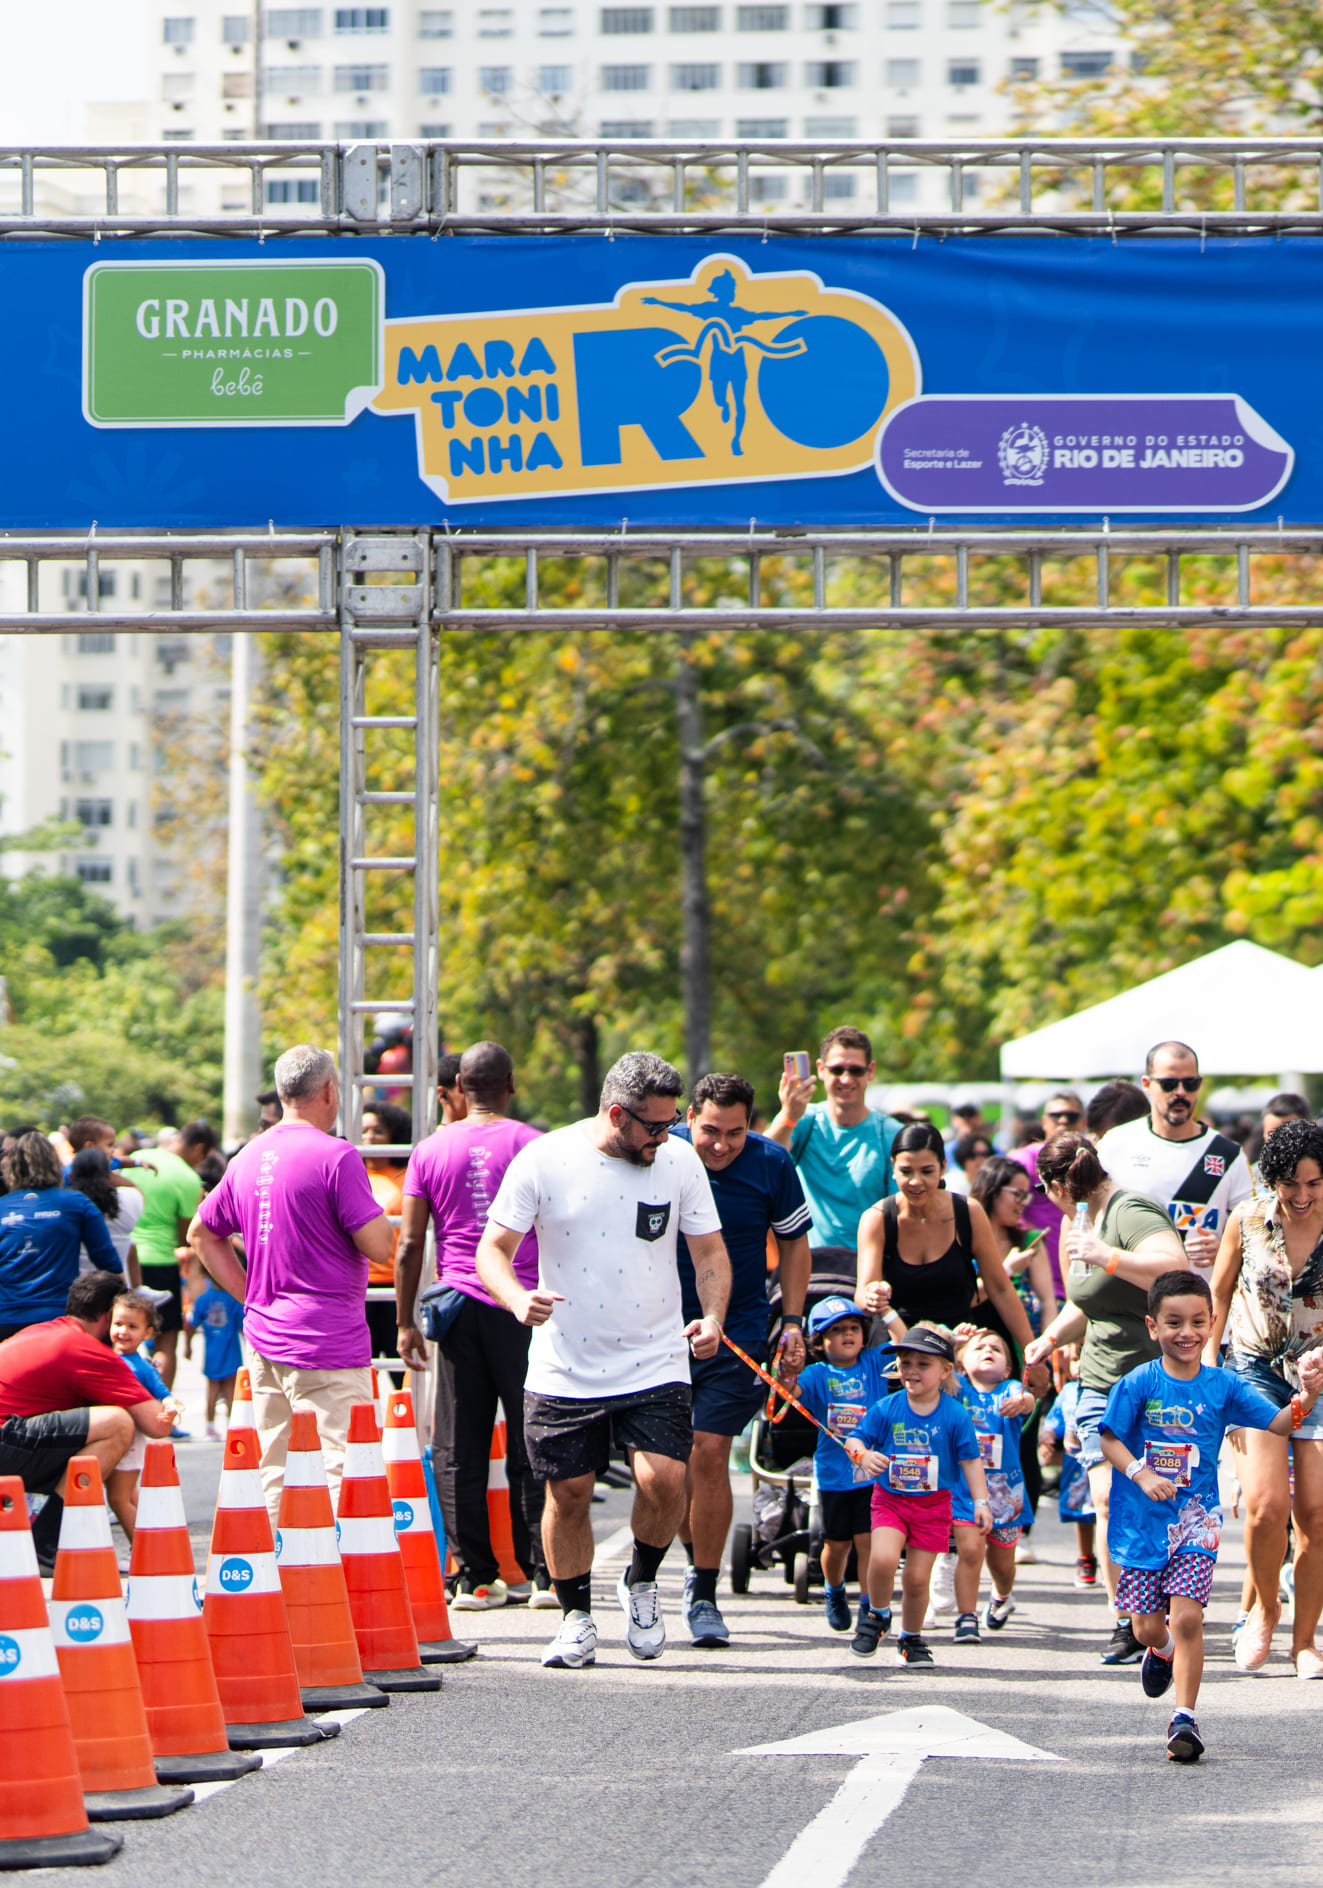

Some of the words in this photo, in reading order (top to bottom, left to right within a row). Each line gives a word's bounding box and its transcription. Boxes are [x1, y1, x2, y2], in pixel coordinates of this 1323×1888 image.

[135, 297, 338, 339] GRANADO
[397, 337, 557, 386] MARA
[210, 367, 264, 396] bebê
[430, 383, 560, 429] TONI
[1053, 435, 1137, 446] GOVERNO
[1145, 435, 1168, 446] DO
[1176, 435, 1245, 446] ESTADO
[448, 431, 563, 477] NHA
[903, 448, 955, 458] Secretaria
[956, 448, 970, 458] de
[1053, 448, 1099, 469] RIO
[1102, 448, 1136, 468] DE
[1139, 448, 1245, 469] JANEIRO
[903, 459, 945, 470] Esporte
[945, 461, 953, 469] e
[954, 459, 983, 469] Lazer
[836, 1415, 858, 1424] 0126
[1153, 1457, 1181, 1467] 2088
[899, 1467, 921, 1476] 1548
[394, 1511, 411, 1521] &S
[222, 1570, 250, 1581] D&S
[68, 1617, 100, 1631] D&S
